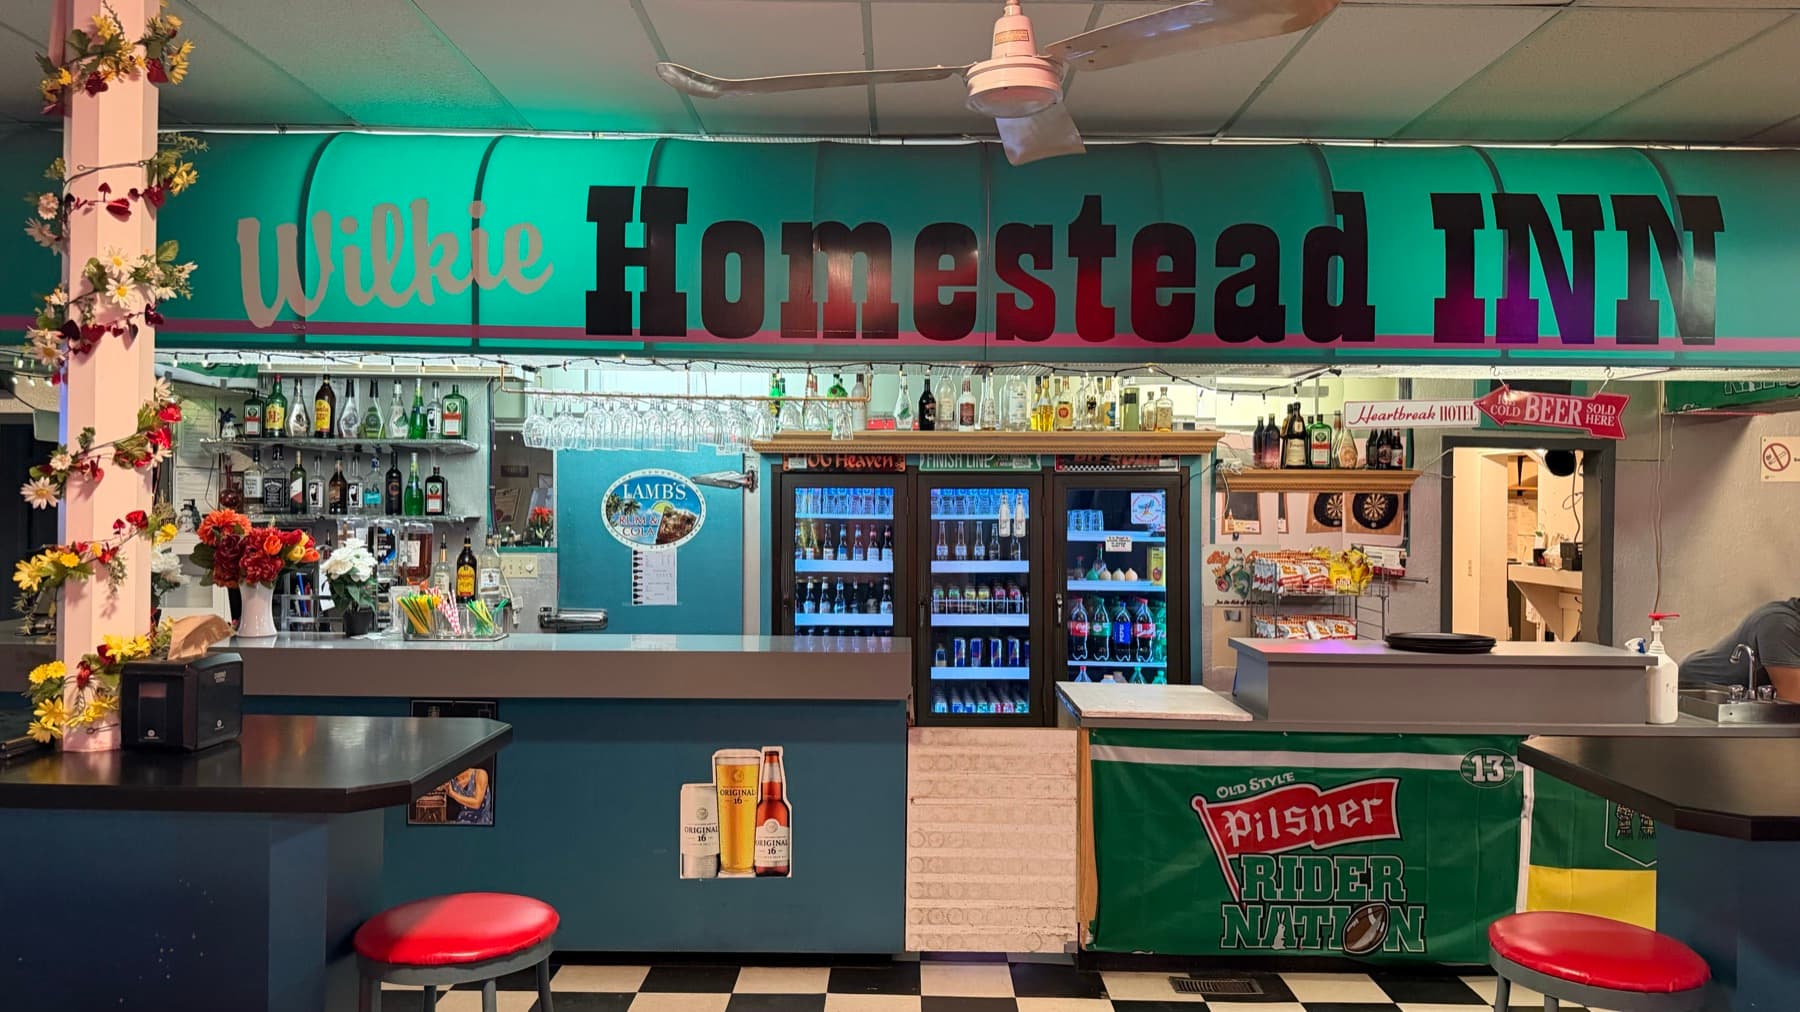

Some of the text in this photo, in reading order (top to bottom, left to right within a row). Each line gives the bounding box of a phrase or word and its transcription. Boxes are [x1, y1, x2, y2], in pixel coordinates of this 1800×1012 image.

[236, 185, 1725, 346] Wilkie Homestead INN
[1348, 404, 1477, 425] Heartbreak HOTEL
[1489, 404, 1521, 417] COLD
[1523, 395, 1582, 426] BEER
[1585, 403, 1616, 416] SOLD
[1585, 414, 1615, 427] HERE
[835, 454, 893, 469] Heaven
[927, 454, 962, 469] FINISH
[966, 454, 991, 469] LINE
[623, 482, 687, 501] LAMB'S
[619, 514, 659, 526] RUM &
[622, 527, 656, 537] COLA
[1471, 754, 1506, 783] 13
[719, 788, 756, 797] ORIGINAL
[1216, 771, 1296, 799] OLD STYLE
[733, 797, 743, 805] 16
[684, 825, 719, 834] ORIGINAL
[1223, 796, 1385, 849] Pilsner
[697, 834, 707, 842] 16
[768, 847, 777, 855] 16
[1240, 855, 1408, 903] RIDER
[1220, 903, 1426, 954] NATION
